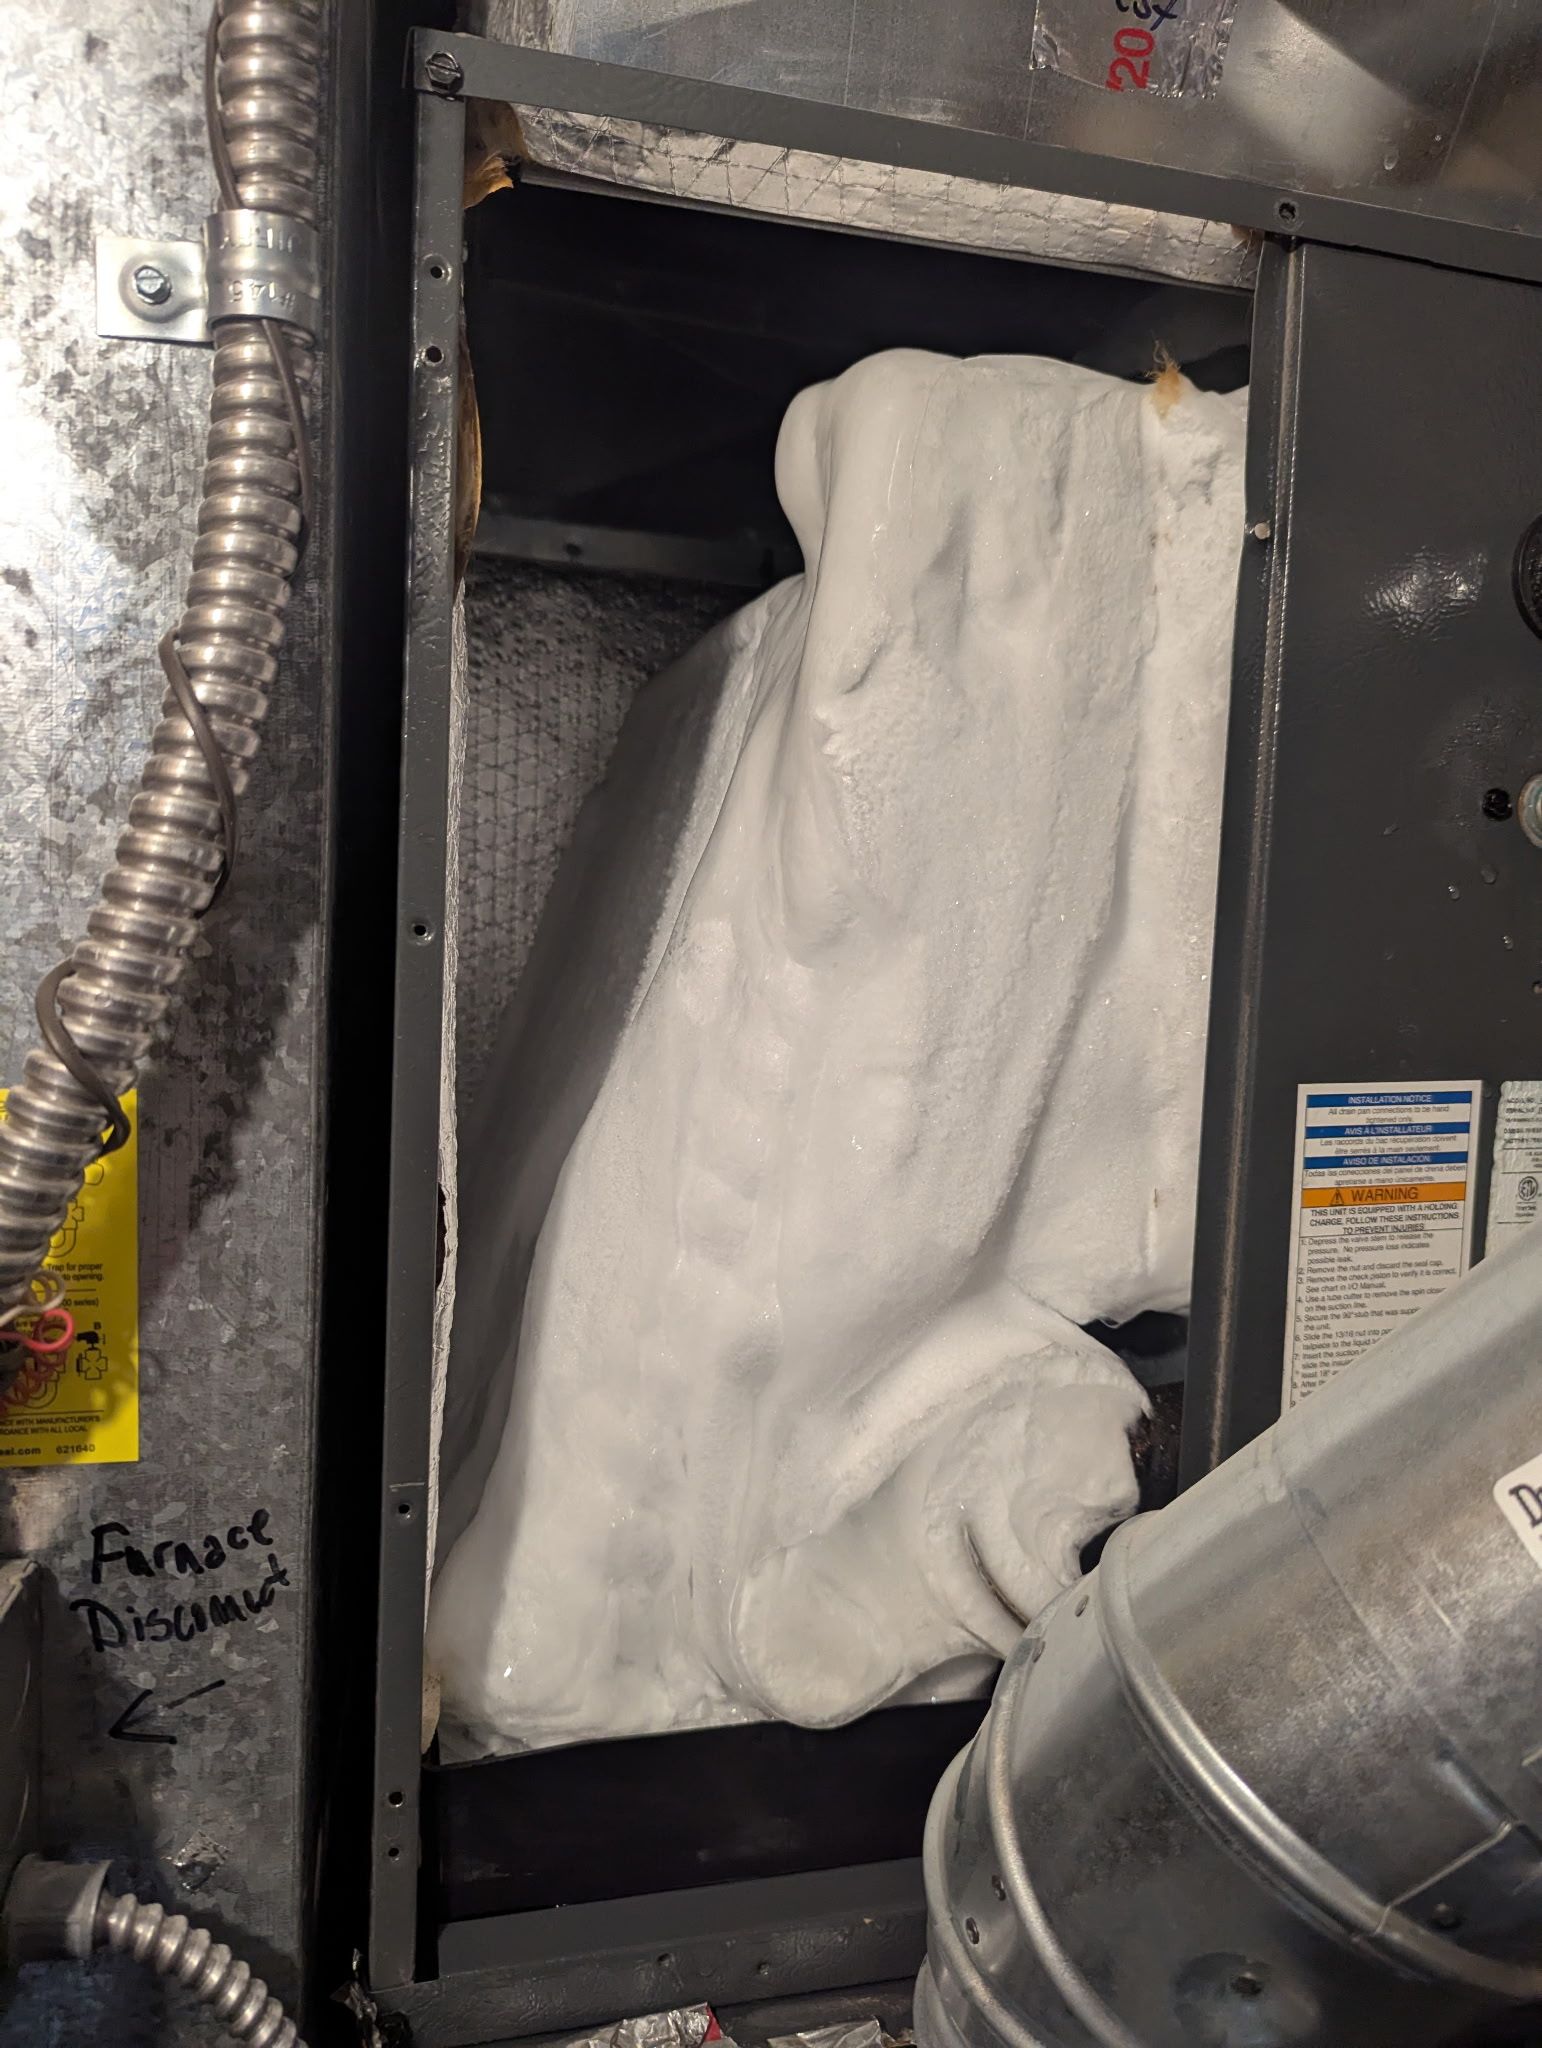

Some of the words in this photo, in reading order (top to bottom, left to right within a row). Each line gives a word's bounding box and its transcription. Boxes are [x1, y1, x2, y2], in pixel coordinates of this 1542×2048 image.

[1348, 1095, 1402, 1104] INSTALLATION
[1403, 1094, 1432, 1103] NOTICE
[1344, 1127, 1363, 1135] AVIS
[1343, 1158, 1366, 1166] AVISO
[1368, 1157, 1380, 1165] DE
[1351, 1186, 1419, 1202] WARNING
[1311, 1209, 1328, 1217] THIS
[1358, 1206, 1395, 1214] EQUIPPED
[1346, 1216, 1378, 1224] FOLLOW
[1379, 1214, 1403, 1222] THESE
[1405, 1212, 1459, 1221] INSTRUCTIONS
[1343, 1227, 1353, 1235] TO
[1355, 1225, 1391, 1234] PREVENT
[1391, 1223, 1424, 1232] INJURIES
[47, 1263, 64, 1272] Trap
[66, 1262, 77, 1271] for
[78, 1263, 103, 1273] proper
[72, 1273, 104, 1282] opening.
[74, 1297, 99, 1307] series)
[64, 1425, 88, 1433] LOCAL
[56, 1444, 96, 1455] 621640
[90, 1508, 274, 1585] Furnace
